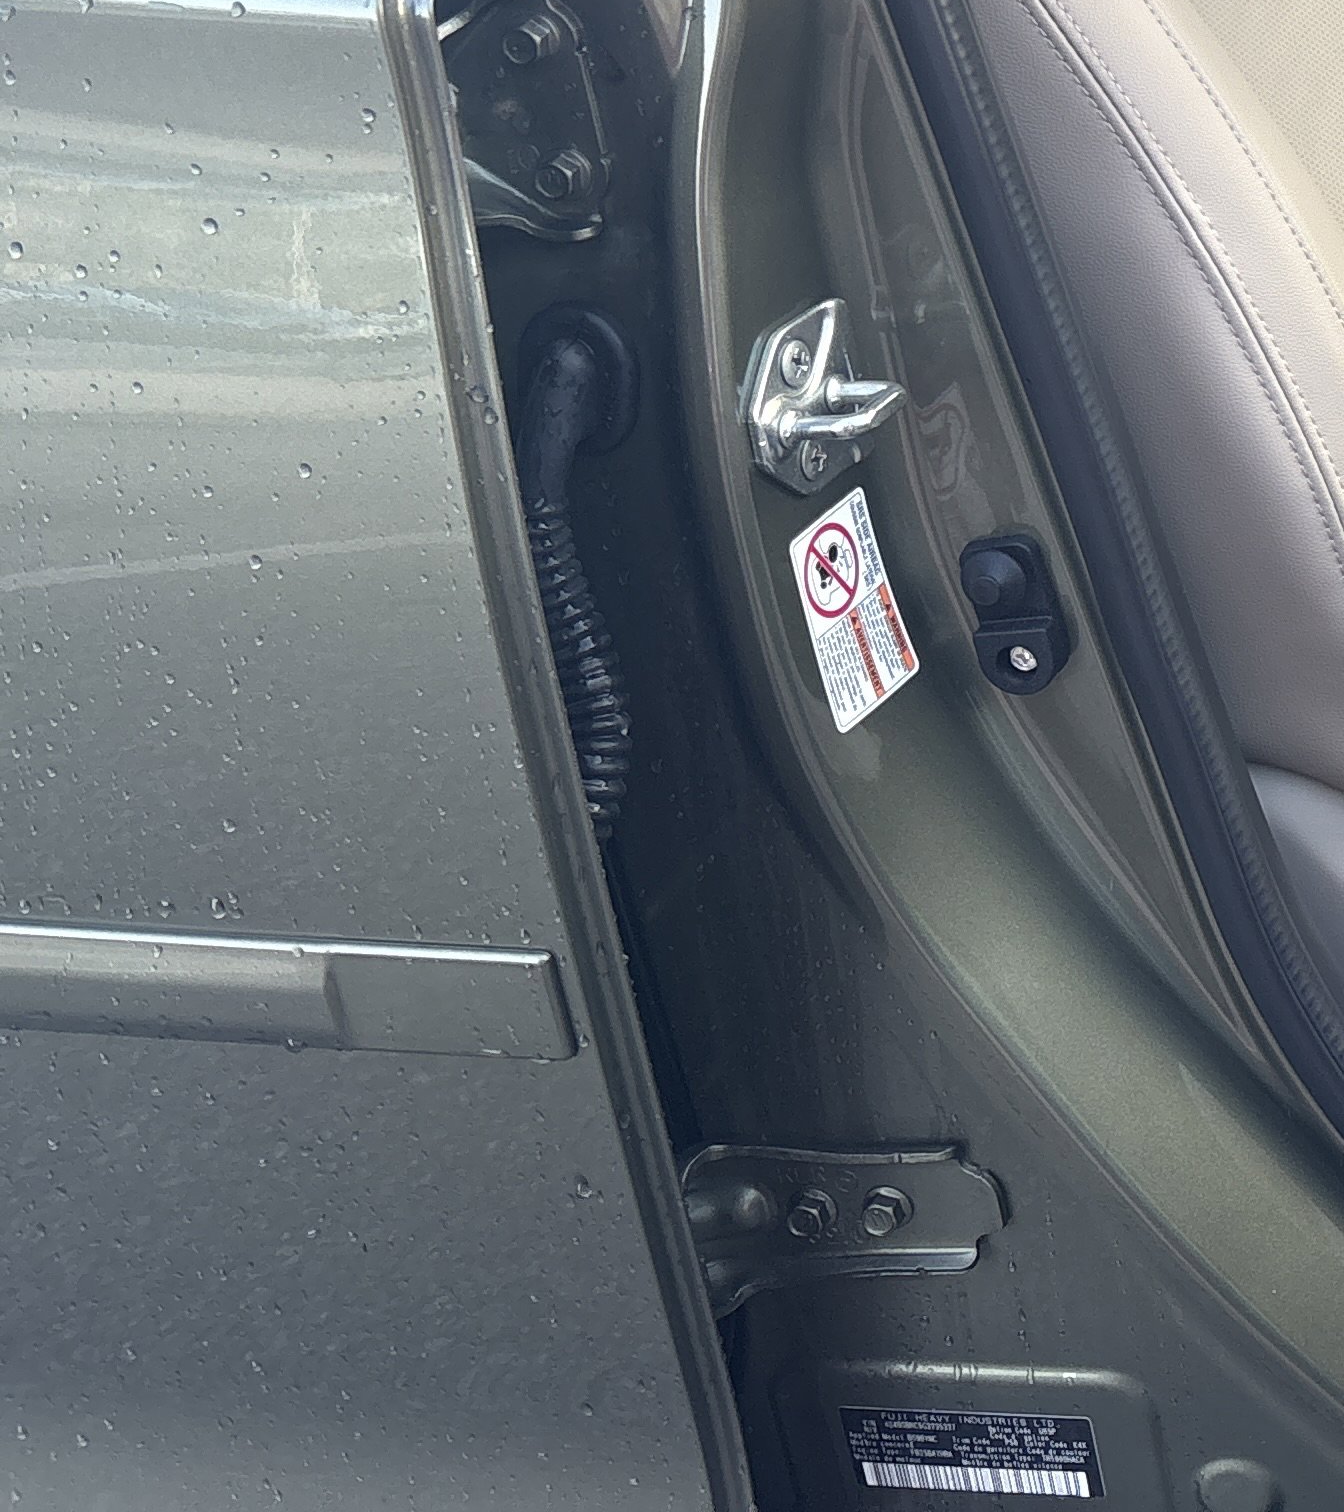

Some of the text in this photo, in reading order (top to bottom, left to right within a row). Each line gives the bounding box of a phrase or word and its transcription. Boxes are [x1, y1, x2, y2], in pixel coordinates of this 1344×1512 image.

[880, 1411, 908, 1421] FUJI
[915, 1413, 951, 1422] HEAVY
[958, 1415, 1027, 1427] INDUSTRIES
